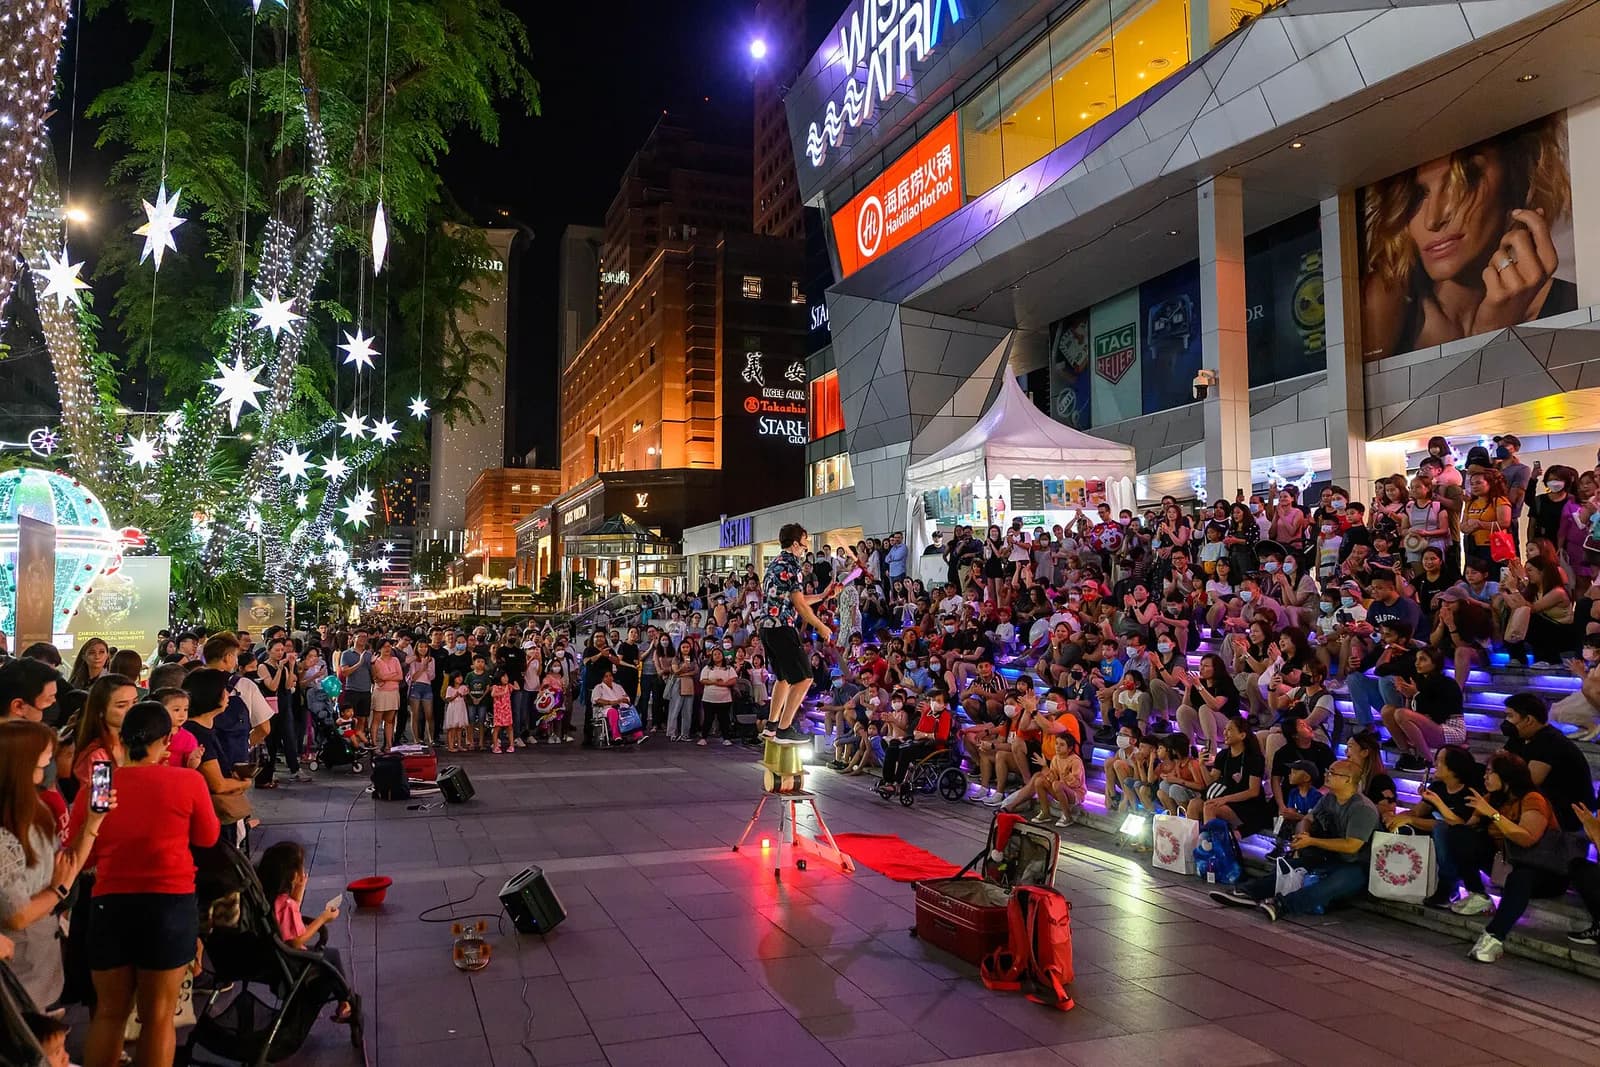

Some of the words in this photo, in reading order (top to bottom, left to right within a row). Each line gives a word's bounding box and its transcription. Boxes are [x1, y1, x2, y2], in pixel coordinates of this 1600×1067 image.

[884, 144, 952, 218] 海底捞火锅
[1099, 329, 1132, 354] TAG
[1098, 350, 1134, 384] HEUER
[763, 387, 784, 398] NGEE
[720, 515, 752, 548] ISETAN
